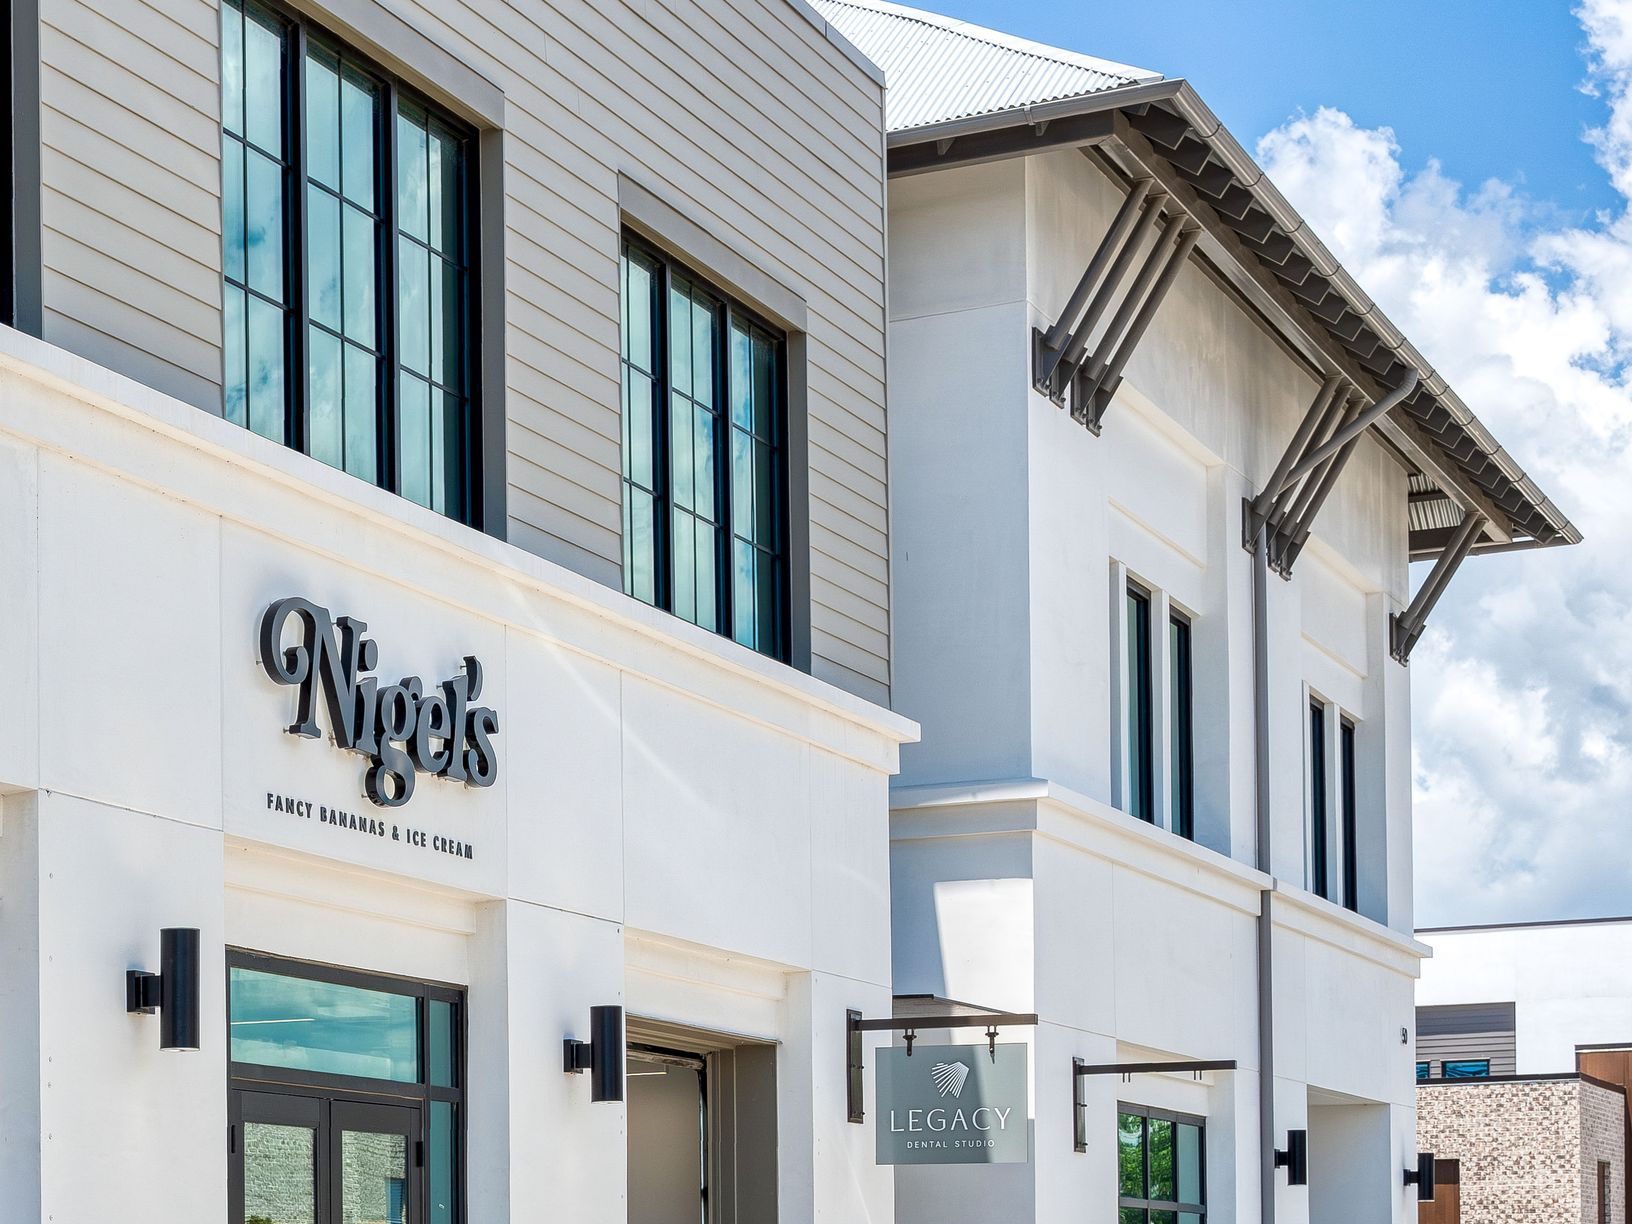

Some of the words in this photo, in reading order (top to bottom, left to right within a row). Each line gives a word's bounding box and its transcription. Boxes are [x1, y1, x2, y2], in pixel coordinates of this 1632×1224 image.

[259, 596, 499, 808] Nigel's
[267, 793, 313, 819] FANCY
[320, 806, 385, 838] BANANAS
[391, 825, 400, 841] &
[406, 828, 427, 847] ICE
[433, 835, 473, 859] CREAM
[890, 1107, 1011, 1132] LEGACY
[907, 1140, 948, 1149] DENTAL
[954, 1139, 995, 1148] STUDIO
